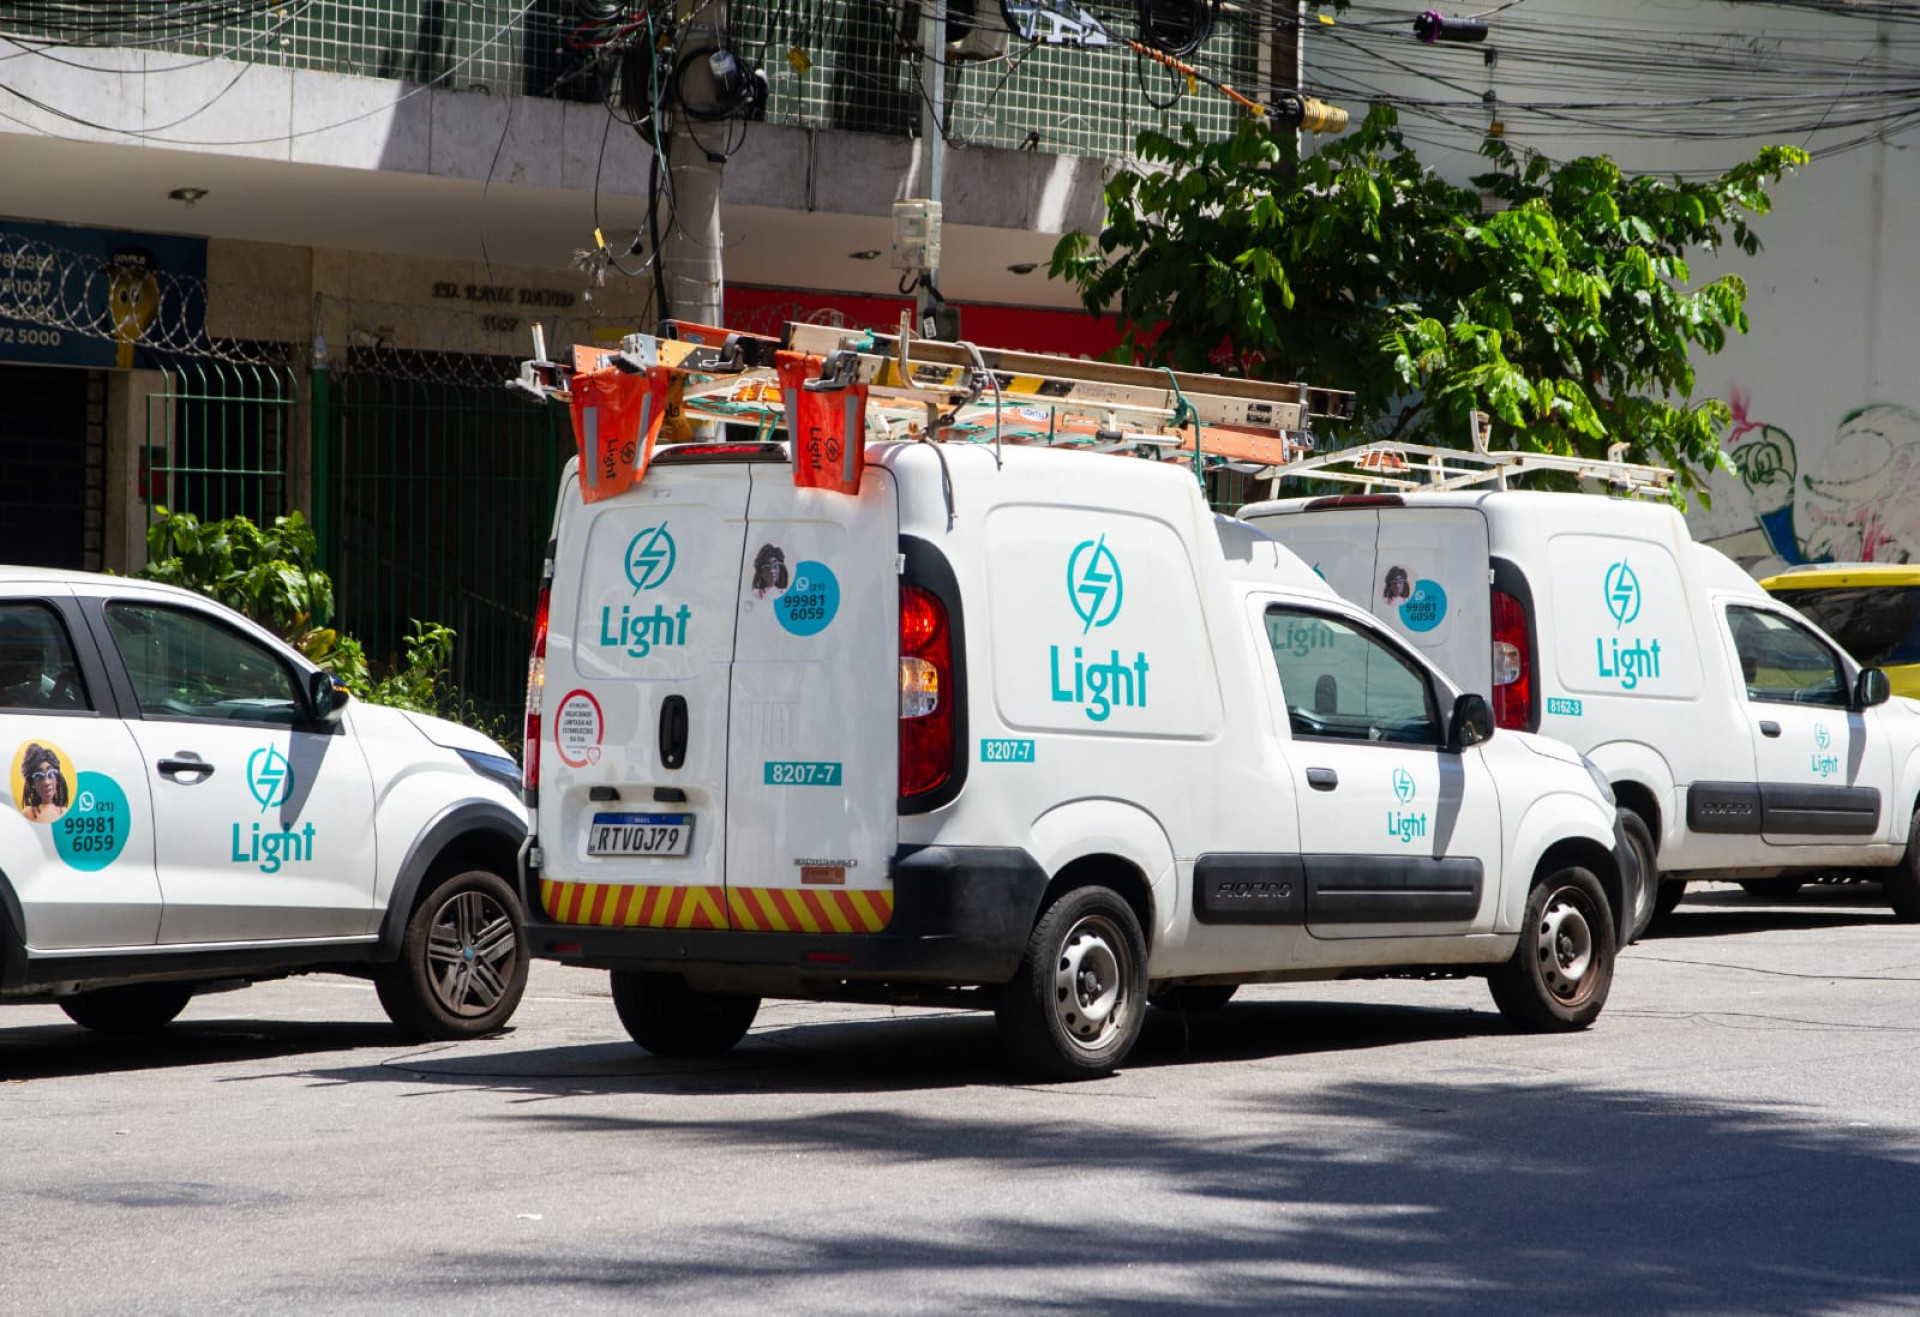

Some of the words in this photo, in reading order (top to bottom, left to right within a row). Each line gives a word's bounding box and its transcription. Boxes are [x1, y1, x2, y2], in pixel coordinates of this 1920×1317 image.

[18, 328, 61, 347] 5000
[603, 438, 619, 479] Light
[806, 426, 822, 470] Light
[784, 594, 825, 609] 99981
[790, 607, 824, 621] 6059
[600, 604, 692, 659] Light
[1596, 636, 1662, 690] Light
[1049, 644, 1150, 722] Light
[987, 741, 1031, 760] 8207-7
[773, 764, 836, 783] 8207-7
[1811, 754, 1838, 778] Light
[95, 800, 115, 812] (21)
[64, 816, 115, 834] 99981
[1387, 811, 1427, 843] Light
[72, 834, 115, 852] 6059
[231, 822, 317, 874] Light
